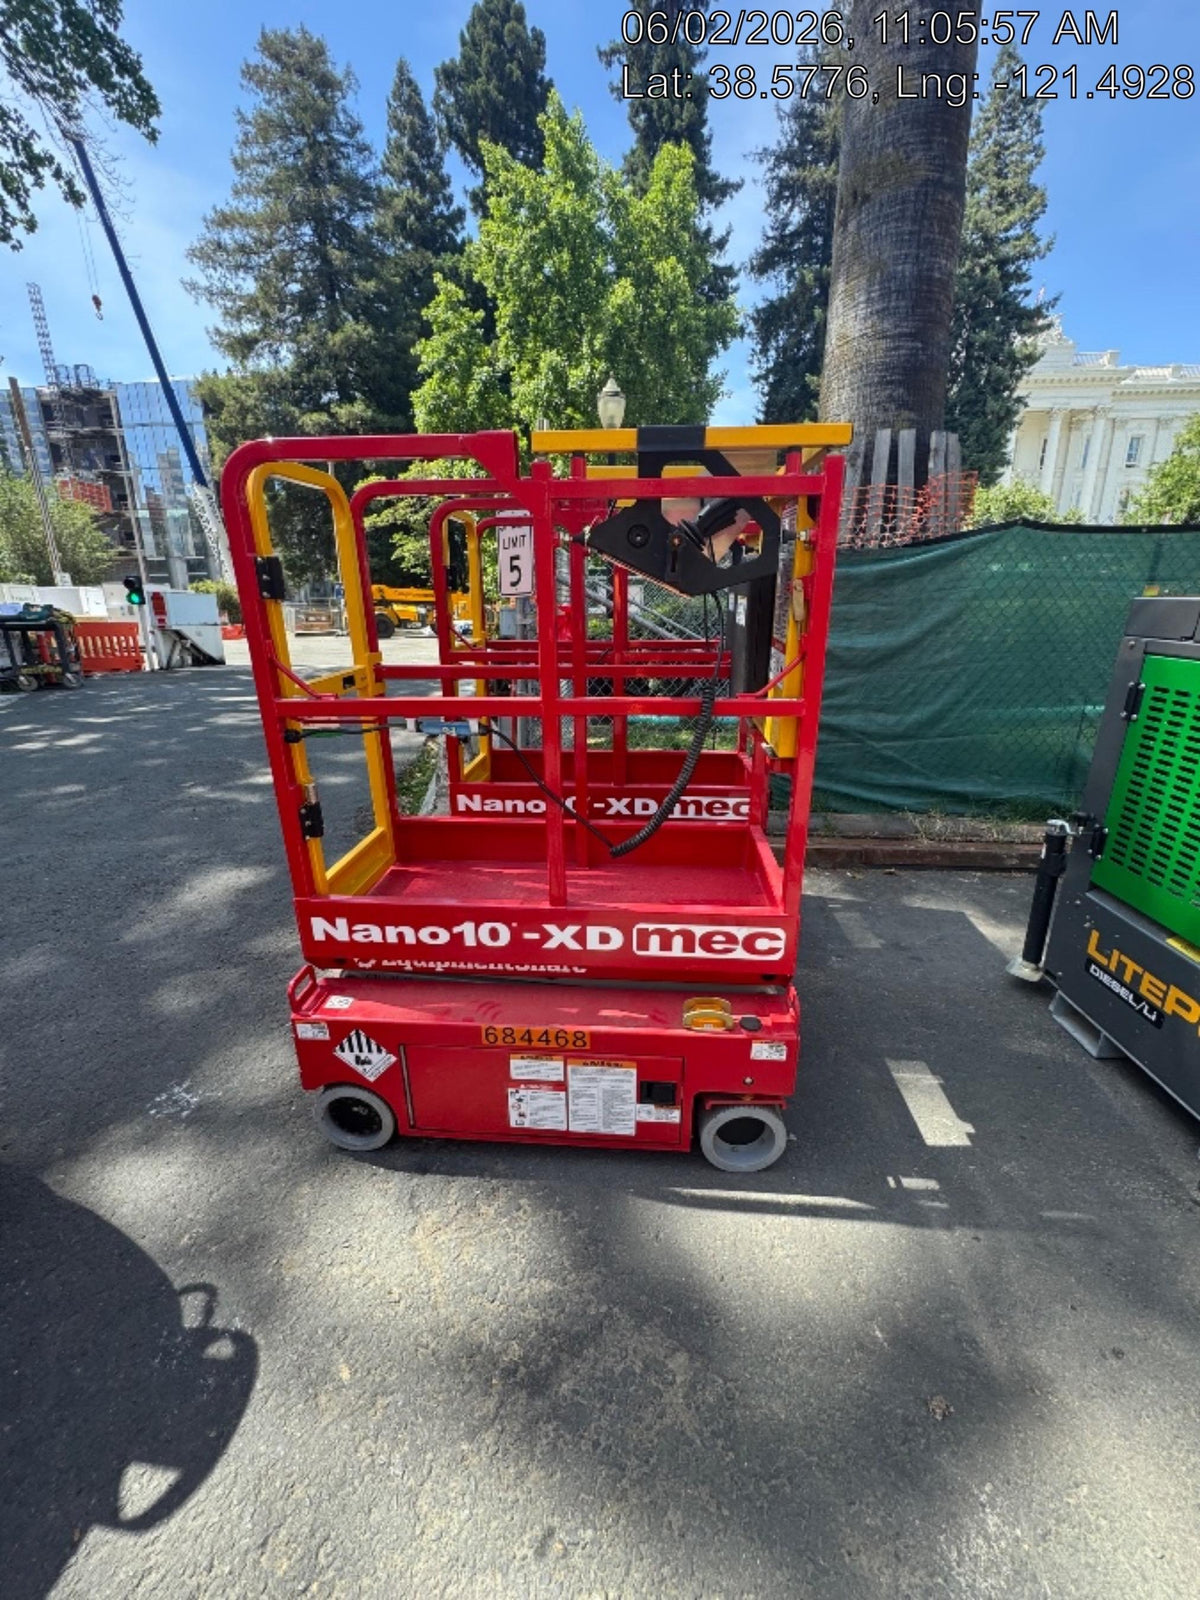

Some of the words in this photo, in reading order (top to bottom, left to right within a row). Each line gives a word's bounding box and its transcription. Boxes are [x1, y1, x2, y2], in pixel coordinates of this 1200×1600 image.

[502, 534, 527, 550] LIMIT
[509, 554, 522, 587] 5
[635, 926, 785, 957] mec
[1087, 928, 1200, 1037] LITEP
[484, 1025, 587, 1048] 684468
